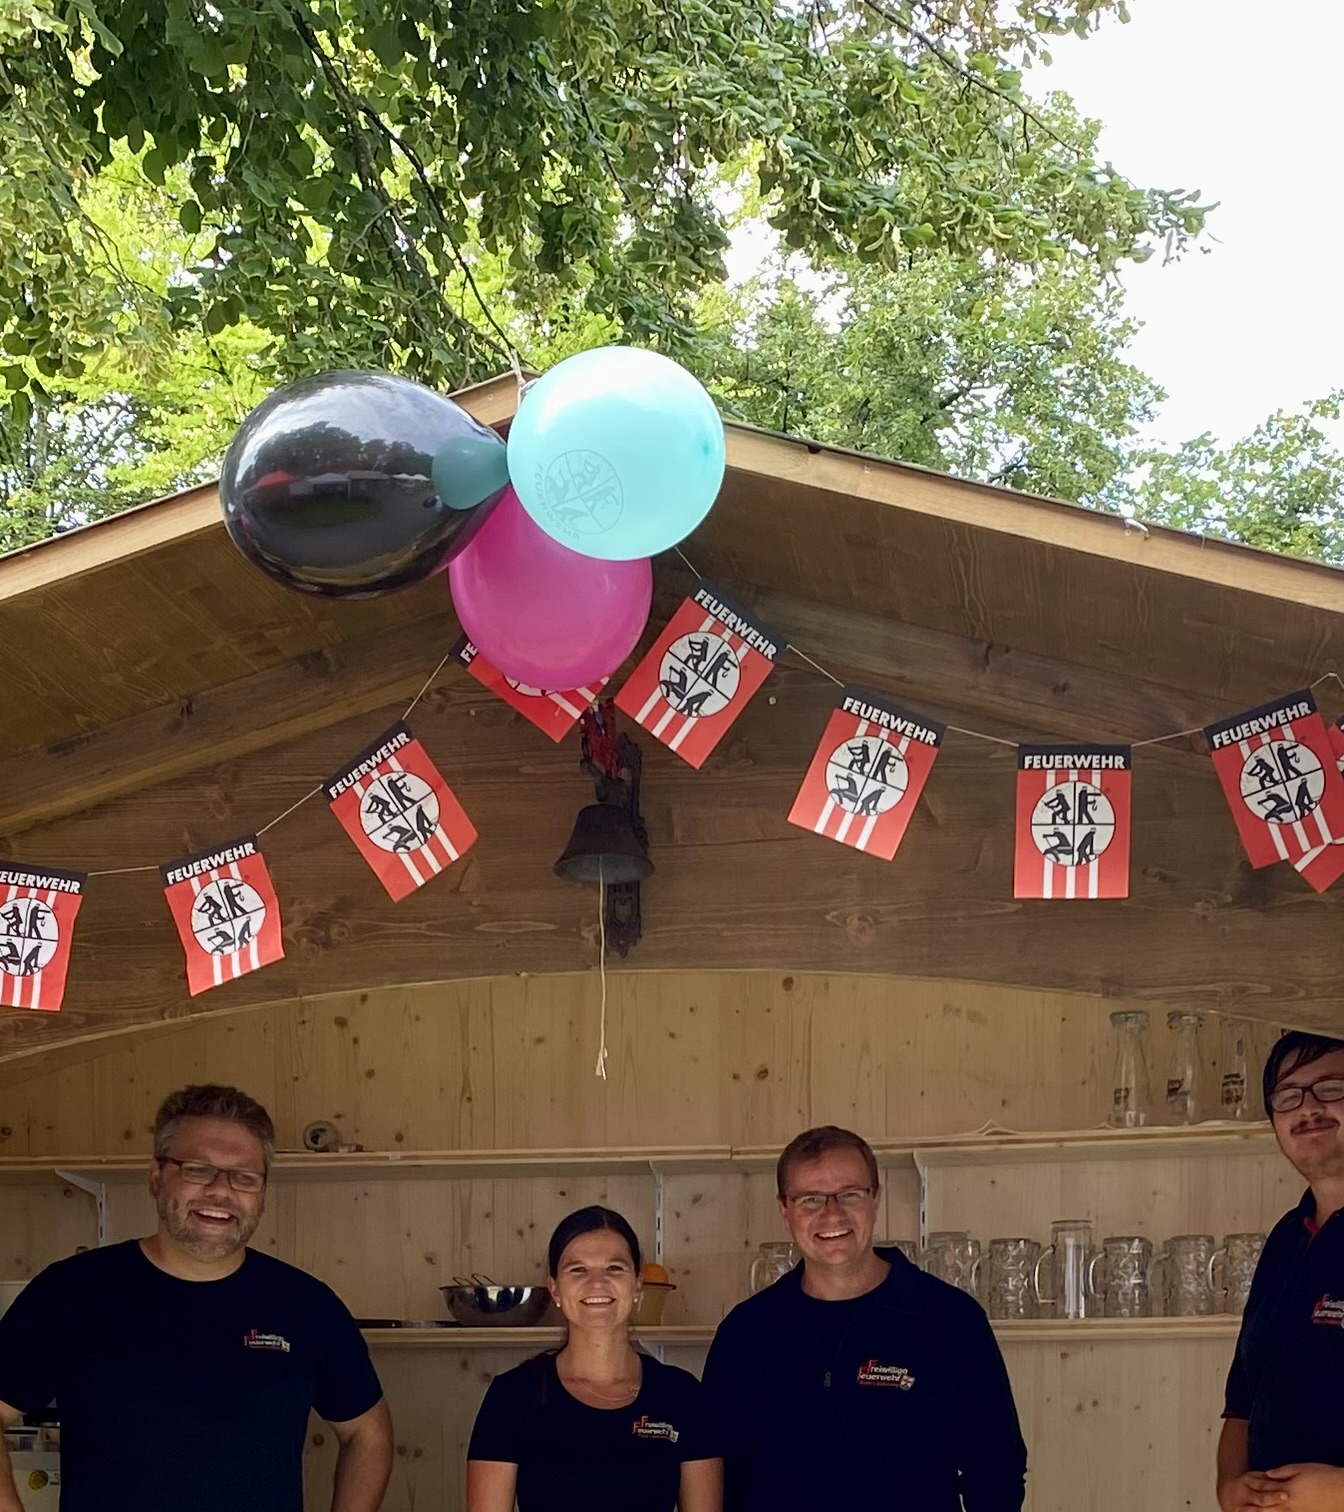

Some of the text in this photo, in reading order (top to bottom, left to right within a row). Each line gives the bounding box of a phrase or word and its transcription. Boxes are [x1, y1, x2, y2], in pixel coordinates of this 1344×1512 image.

[695, 589, 777, 661] FEUERWEHR
[843, 697, 937, 746] FEUERWEHR
[1212, 702, 1313, 748] FEUERWEHR
[329, 730, 413, 801] FEUERWEHR
[1024, 755, 1126, 770] FEUERWEHR
[165, 841, 258, 884] FEUERWEHR
